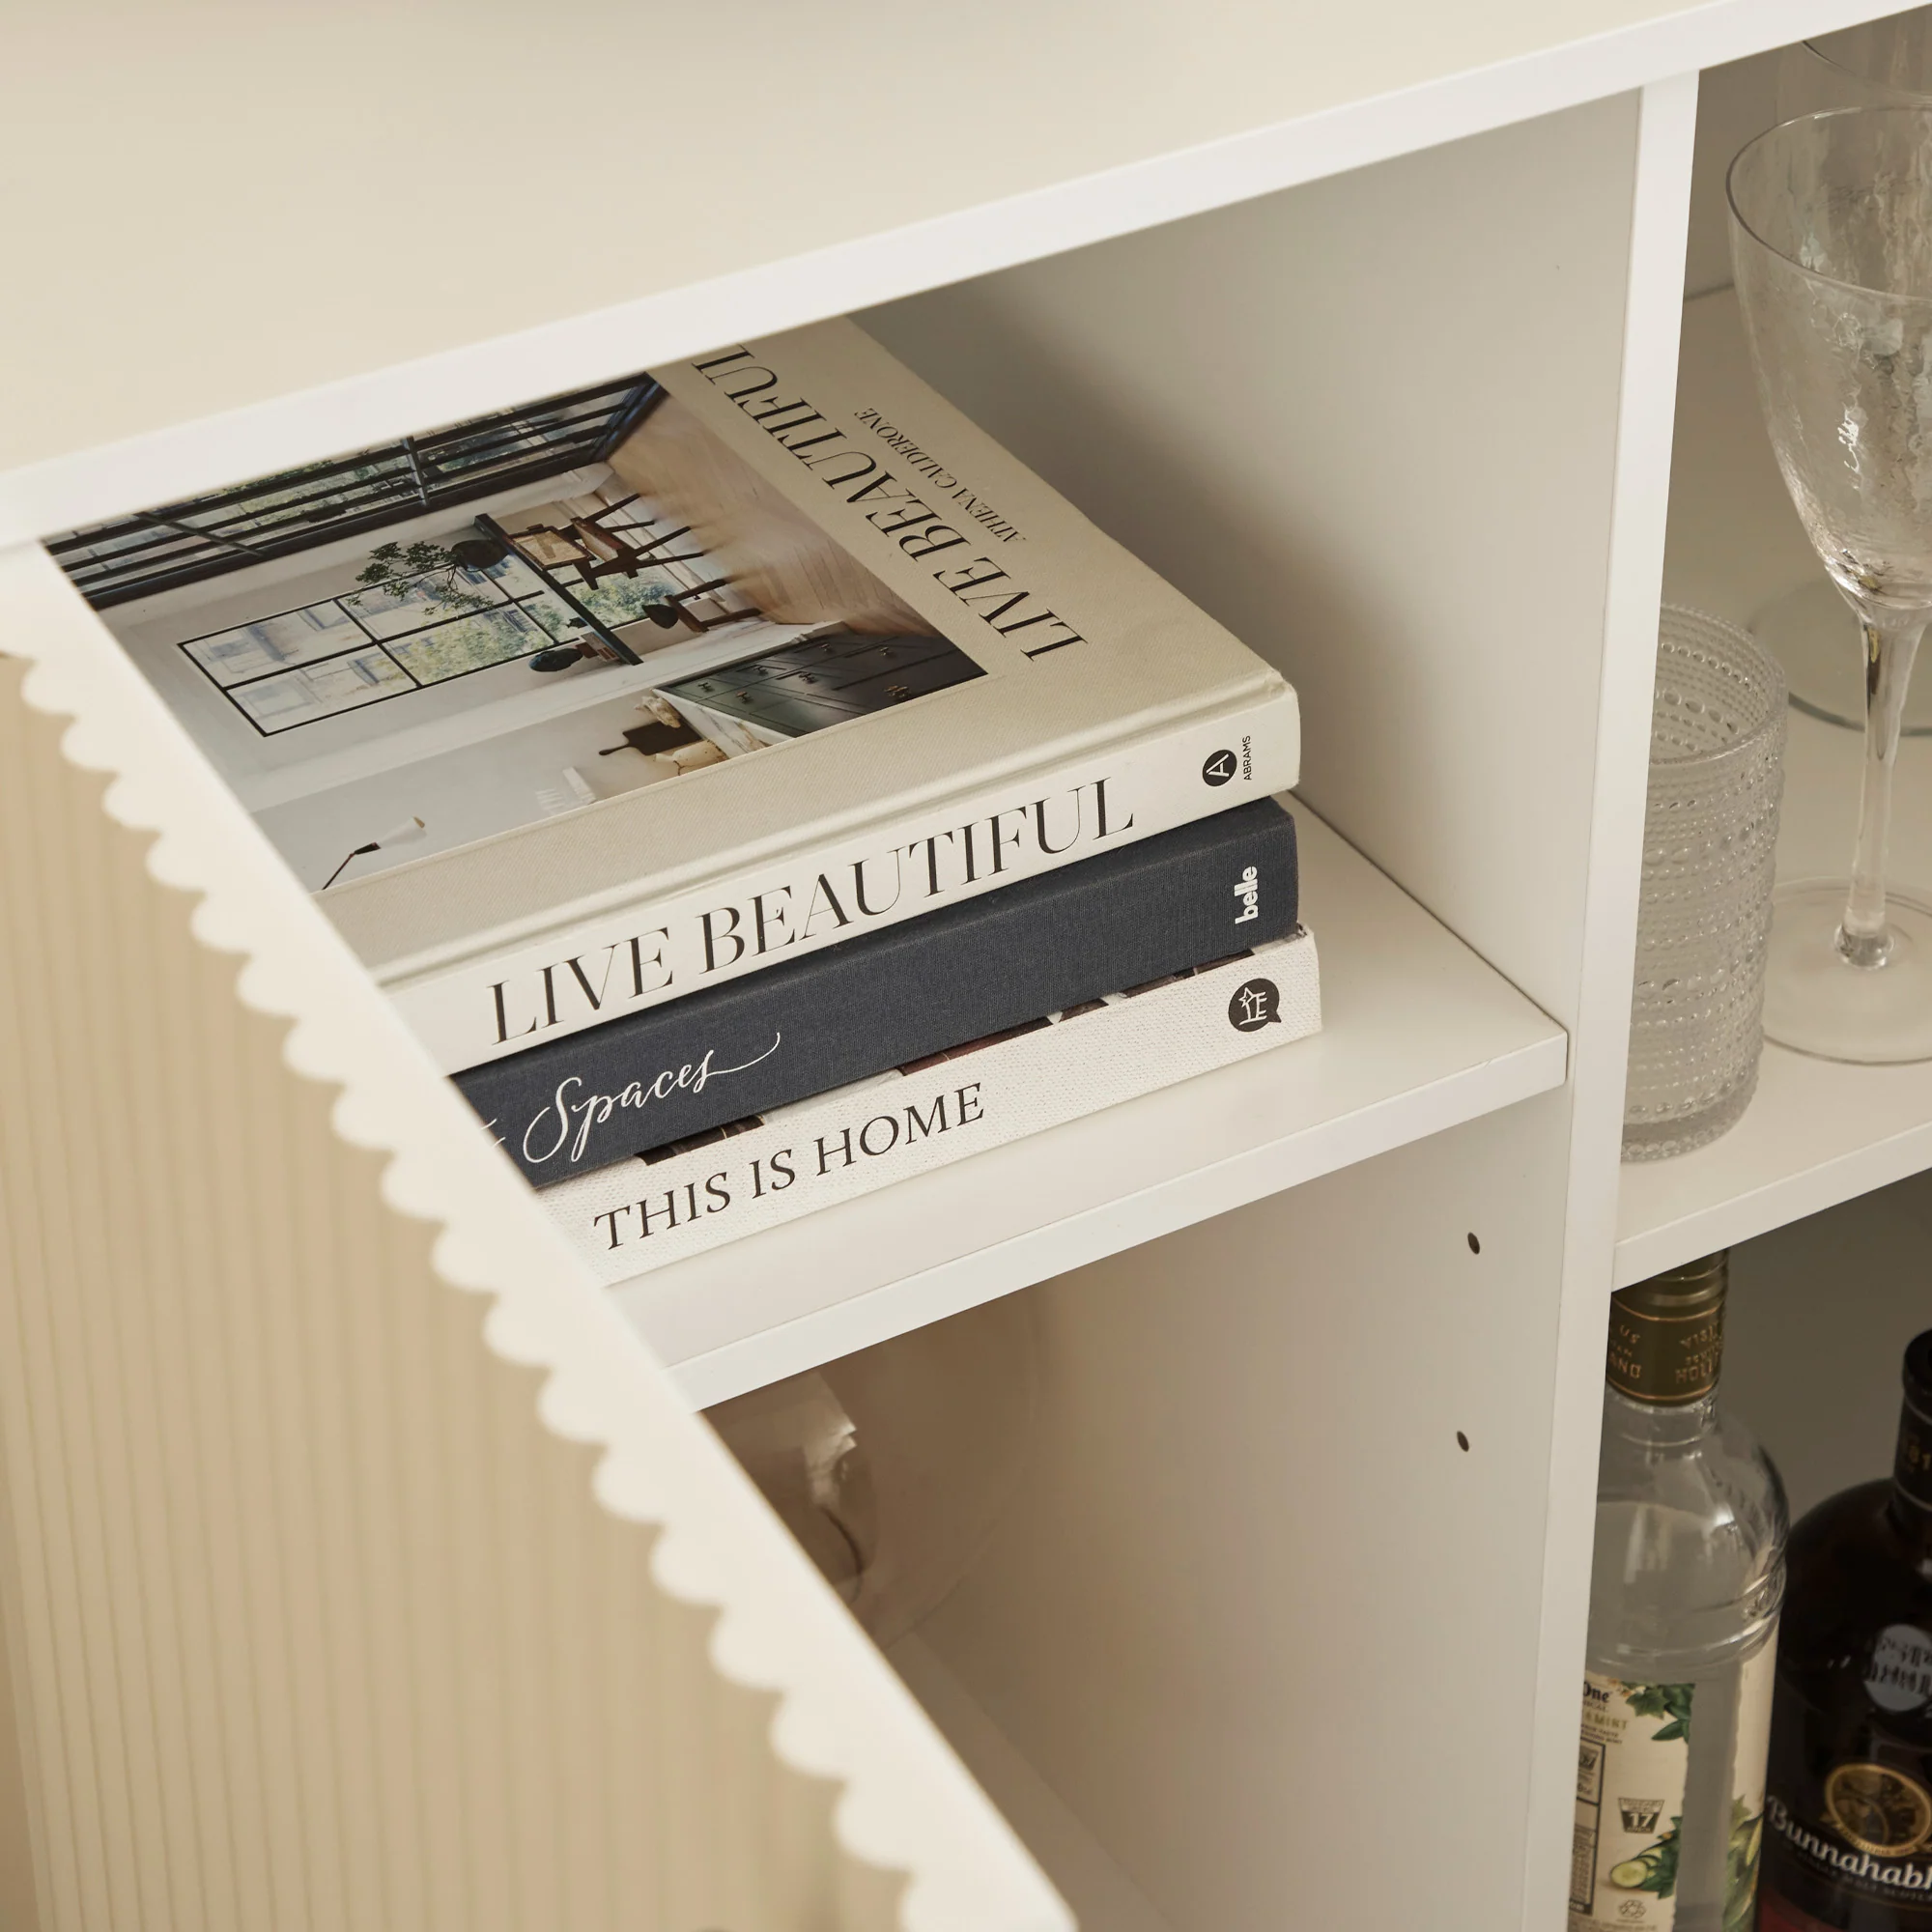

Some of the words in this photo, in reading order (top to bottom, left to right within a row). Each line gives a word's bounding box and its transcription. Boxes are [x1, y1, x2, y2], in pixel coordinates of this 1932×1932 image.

[854, 407, 958, 488] CALDERONE
[952, 487, 1027, 543] ATHENA
[932, 556, 1089, 662] LIVE
[1242, 735, 1252, 781] ABRAMS
[486, 926, 674, 1046] LIVE
[695, 776, 1134, 976] BEAUTIFUL
[1234, 866, 1259, 924] belle
[522, 1032, 781, 1164] Spaces
[593, 1171, 731, 1251] THIS
[750, 1149, 797, 1200] IS
[813, 1082, 984, 1177] HOME
[1629, 1811, 1655, 1828] 17
